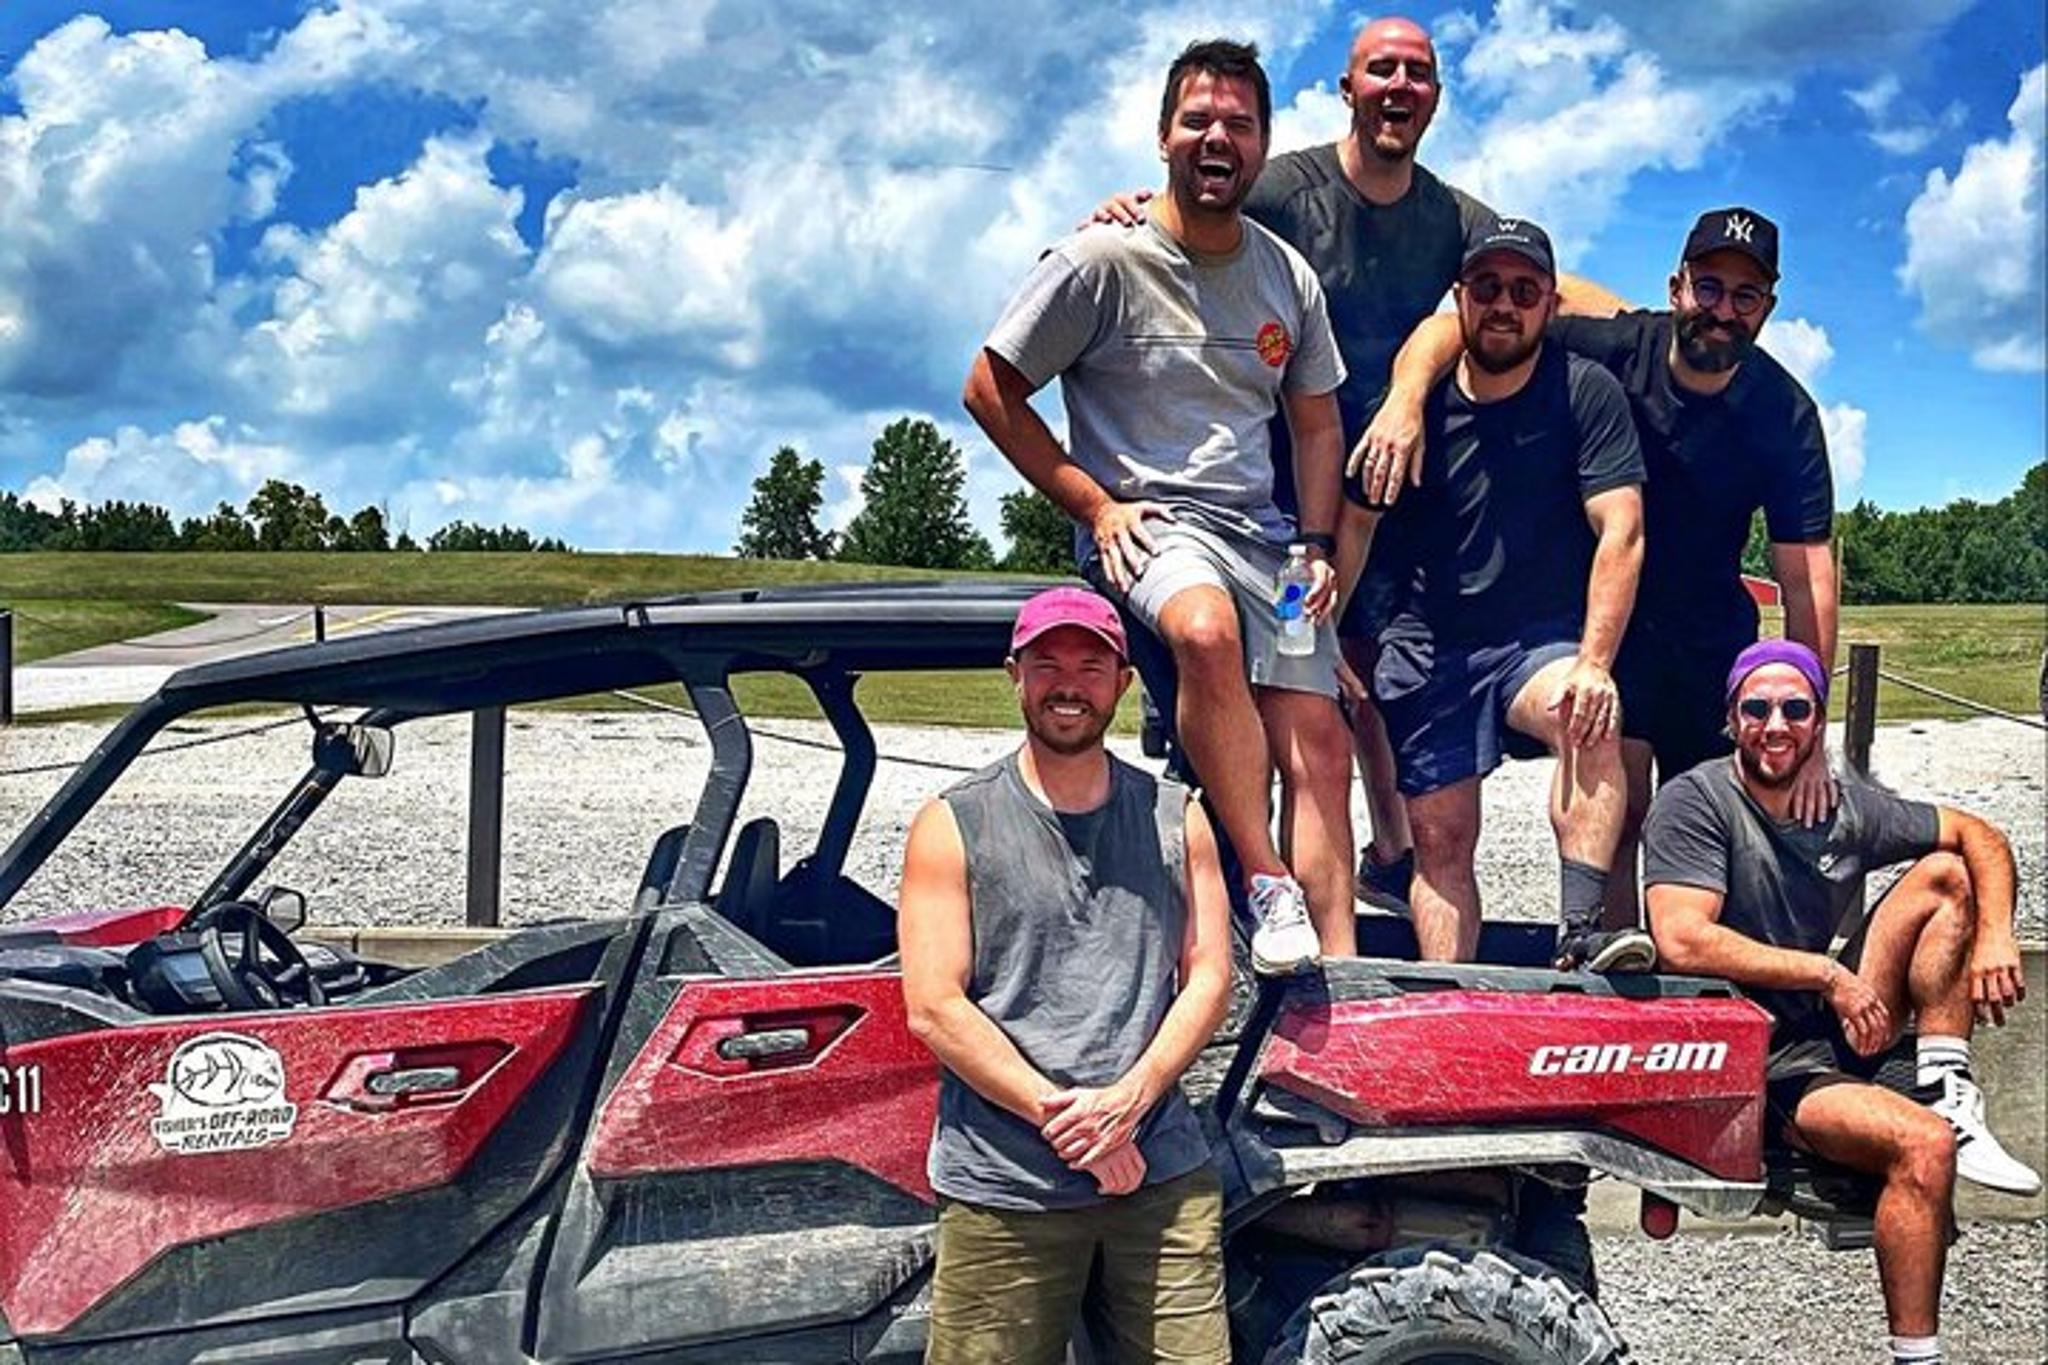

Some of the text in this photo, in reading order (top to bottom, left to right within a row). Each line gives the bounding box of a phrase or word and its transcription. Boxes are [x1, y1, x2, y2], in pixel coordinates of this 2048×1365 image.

[1724, 212, 1754, 243] NY
[1528, 1040, 1729, 1076] can-am
[209, 1106, 294, 1130] OFF-ROAD
[181, 1127, 268, 1150] RENTALS
